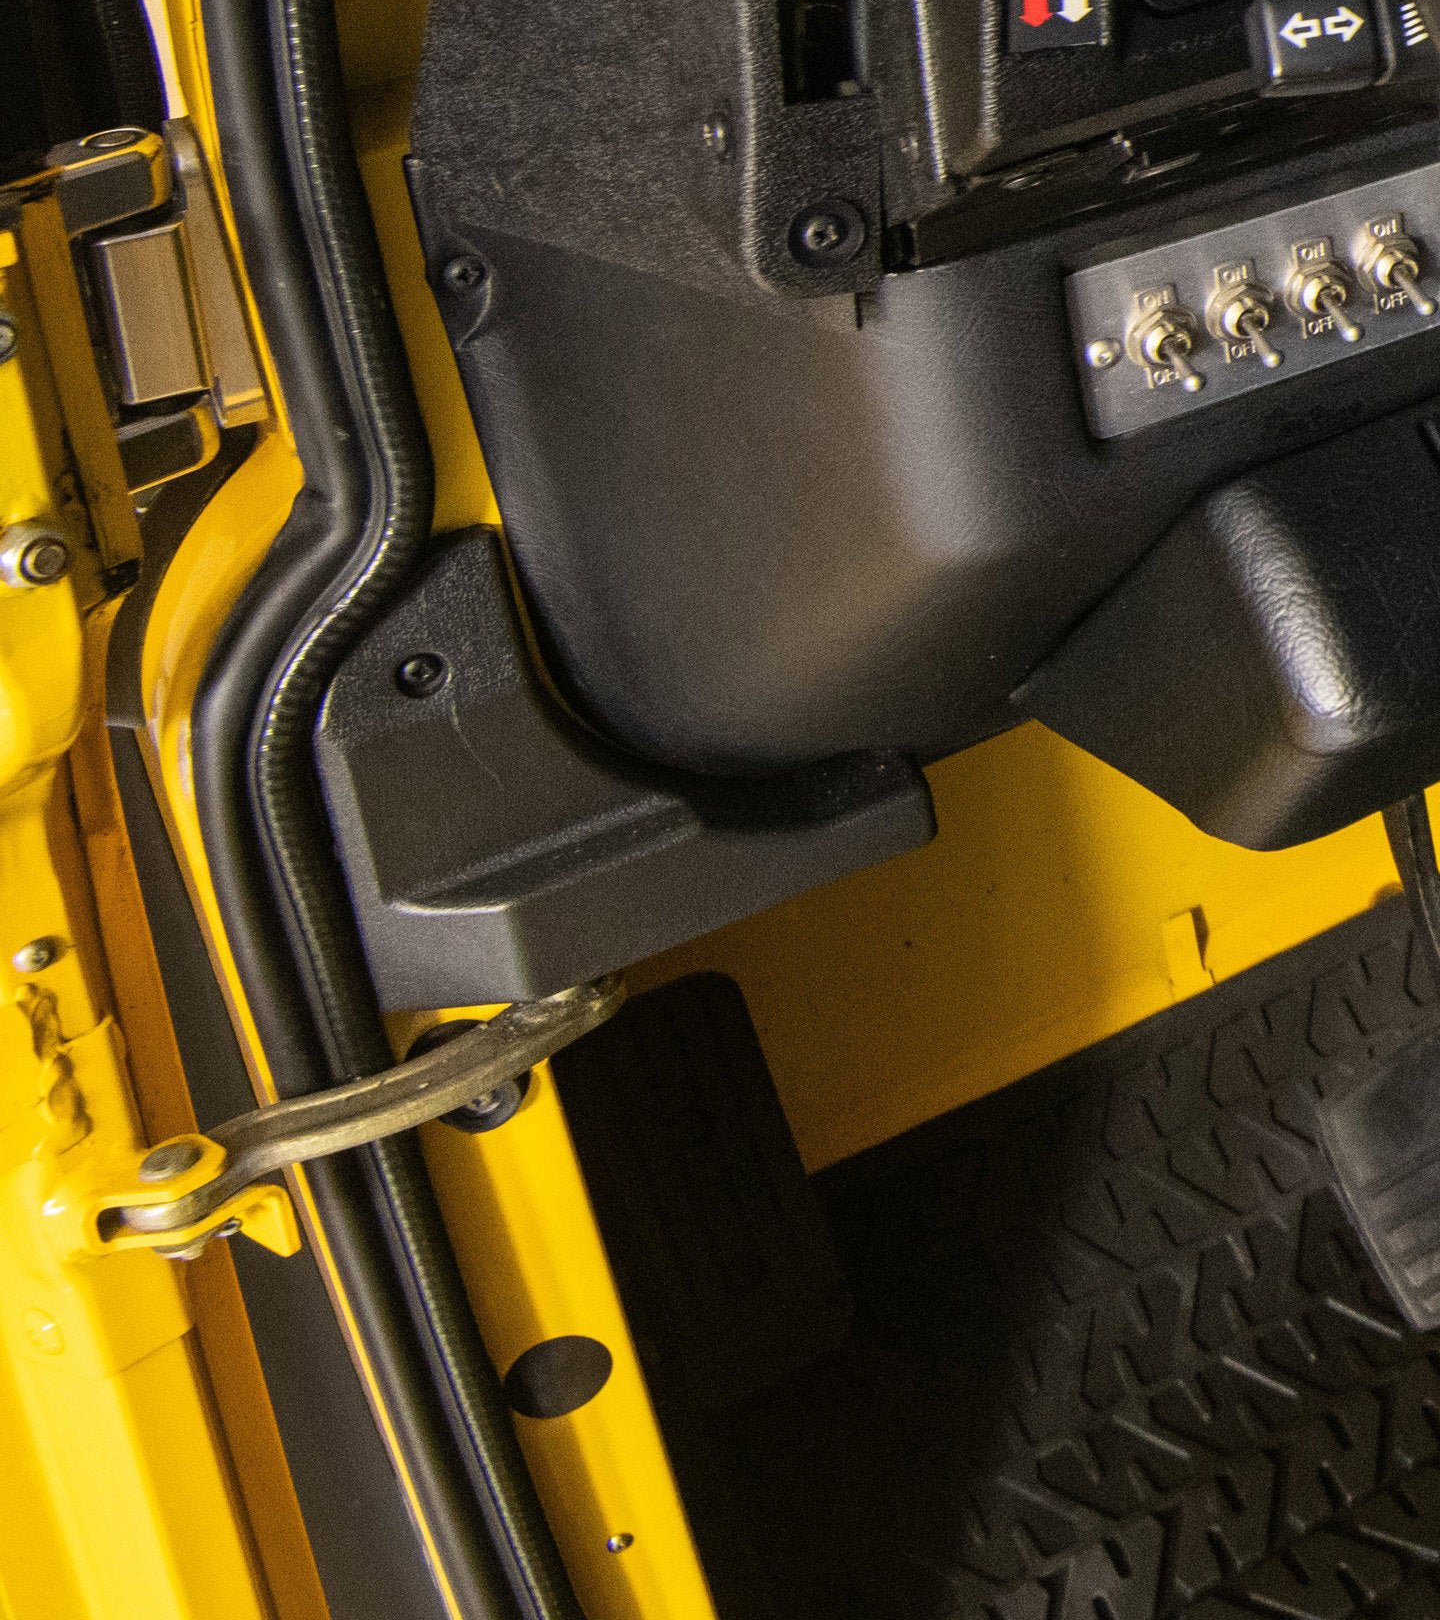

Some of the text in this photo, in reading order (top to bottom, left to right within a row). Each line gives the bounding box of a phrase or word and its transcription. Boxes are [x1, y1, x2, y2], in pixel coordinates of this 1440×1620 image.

[1374, 219, 1397, 237] ON
[1300, 242, 1325, 261] ON
[1223, 265, 1248, 283] ON
[1143, 290, 1169, 308] ON
[1380, 291, 1408, 310] OFF
